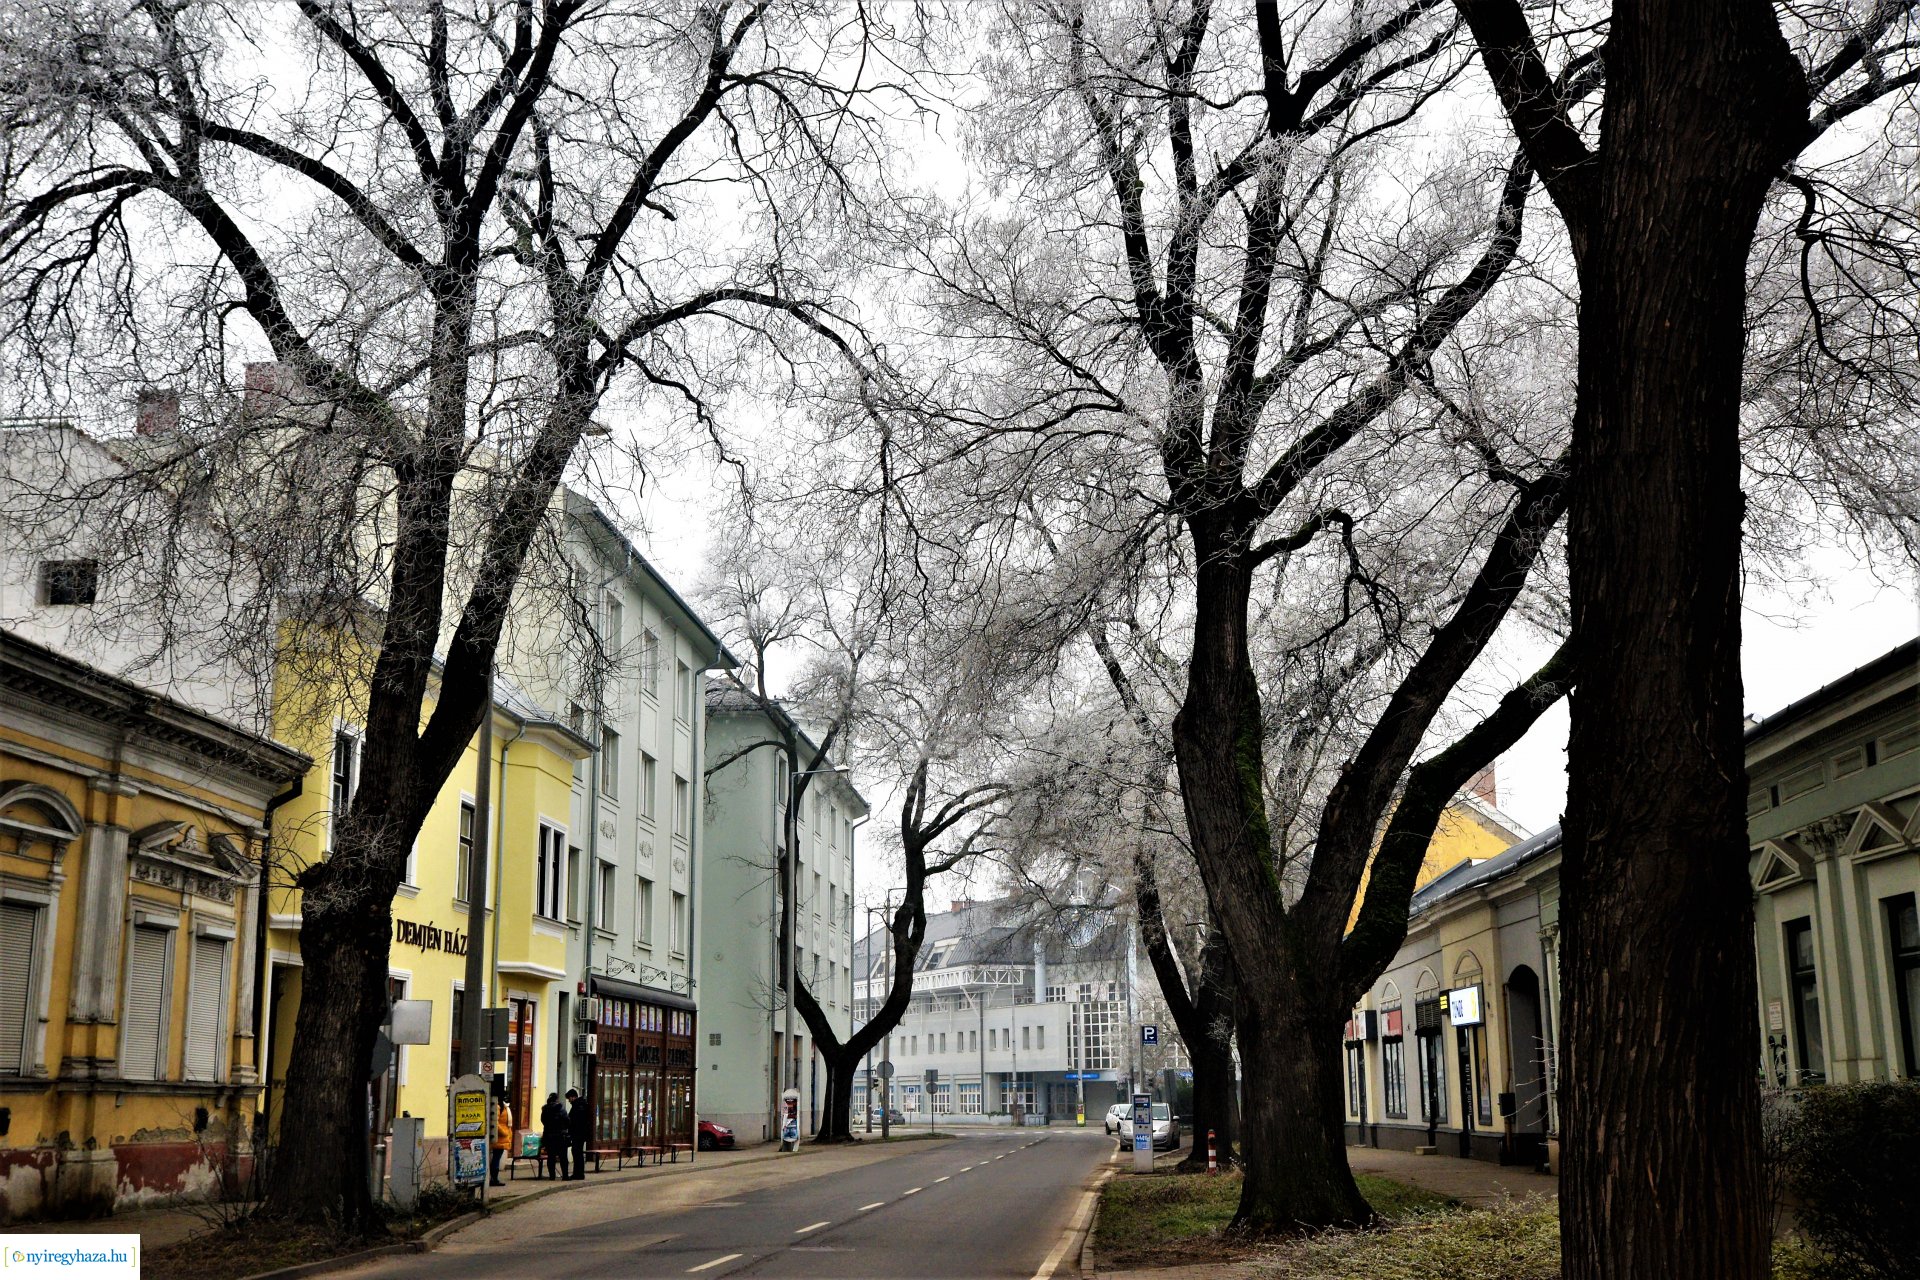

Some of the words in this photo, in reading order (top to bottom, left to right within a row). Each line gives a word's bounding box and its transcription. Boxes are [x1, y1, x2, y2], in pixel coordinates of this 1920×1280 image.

[396, 918, 442, 954] DEMJÉN
[444, 927, 468, 956] HÁZ
[1144, 1027, 1155, 1040] P
